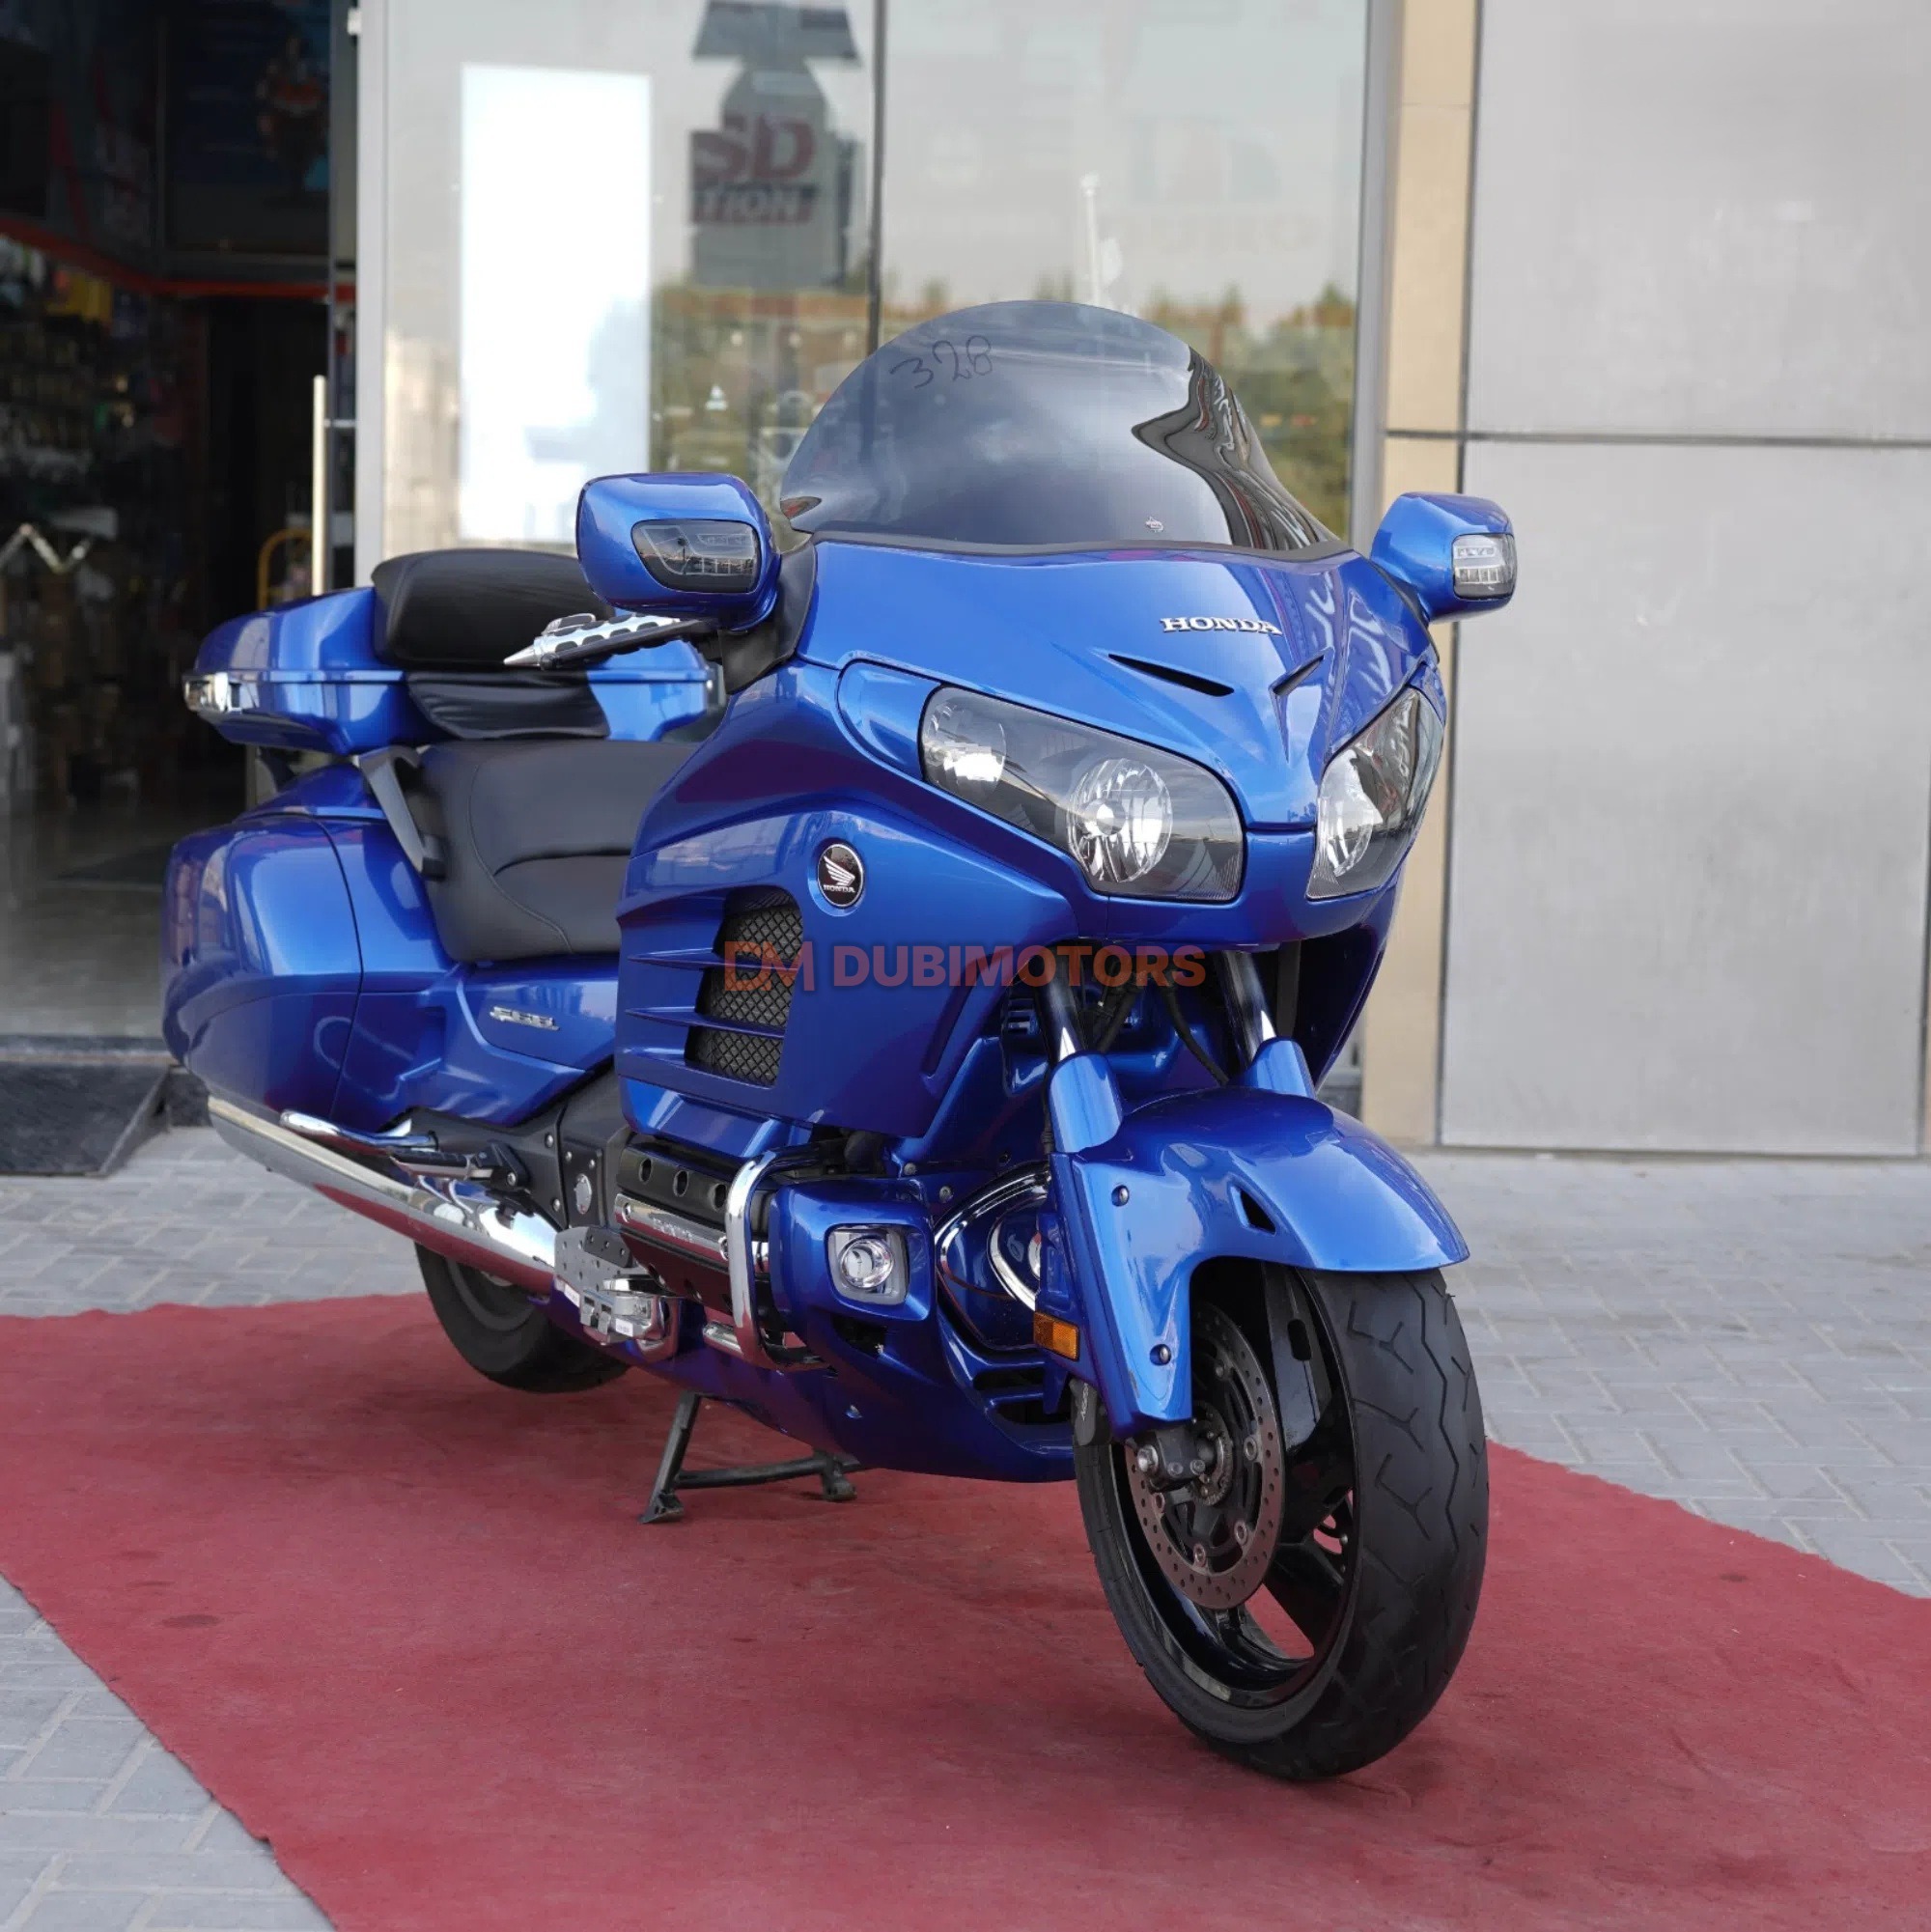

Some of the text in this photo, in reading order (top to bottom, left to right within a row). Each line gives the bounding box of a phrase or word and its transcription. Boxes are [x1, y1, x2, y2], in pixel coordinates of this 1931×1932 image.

[888, 335, 993, 388] 328
[1160, 617, 1283, 635] HONDA
[824, 884, 855, 893] HONDA
